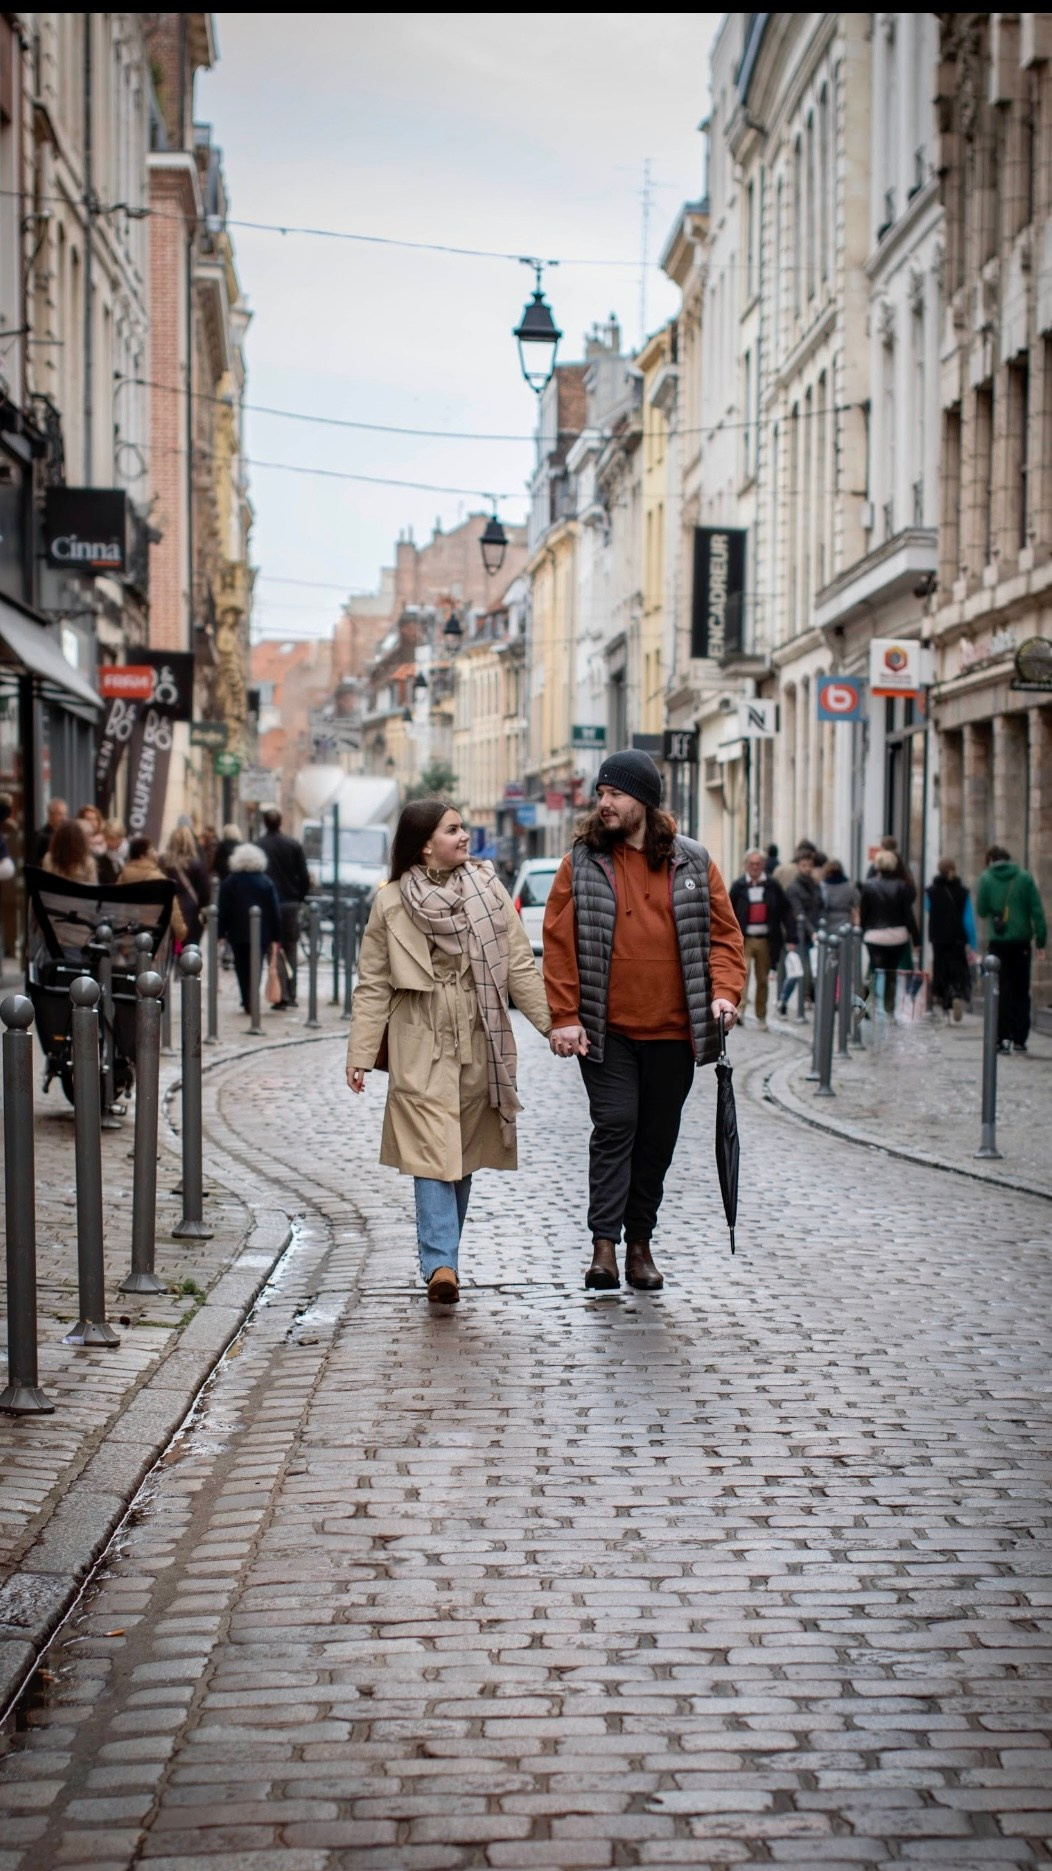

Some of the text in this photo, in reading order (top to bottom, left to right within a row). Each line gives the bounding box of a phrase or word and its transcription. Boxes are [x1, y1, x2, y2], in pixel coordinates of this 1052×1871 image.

[51, 534, 121, 560] Cinna
[707, 534, 729, 658] ENCADREUR
[129, 745, 156, 829] OLUFSEN
